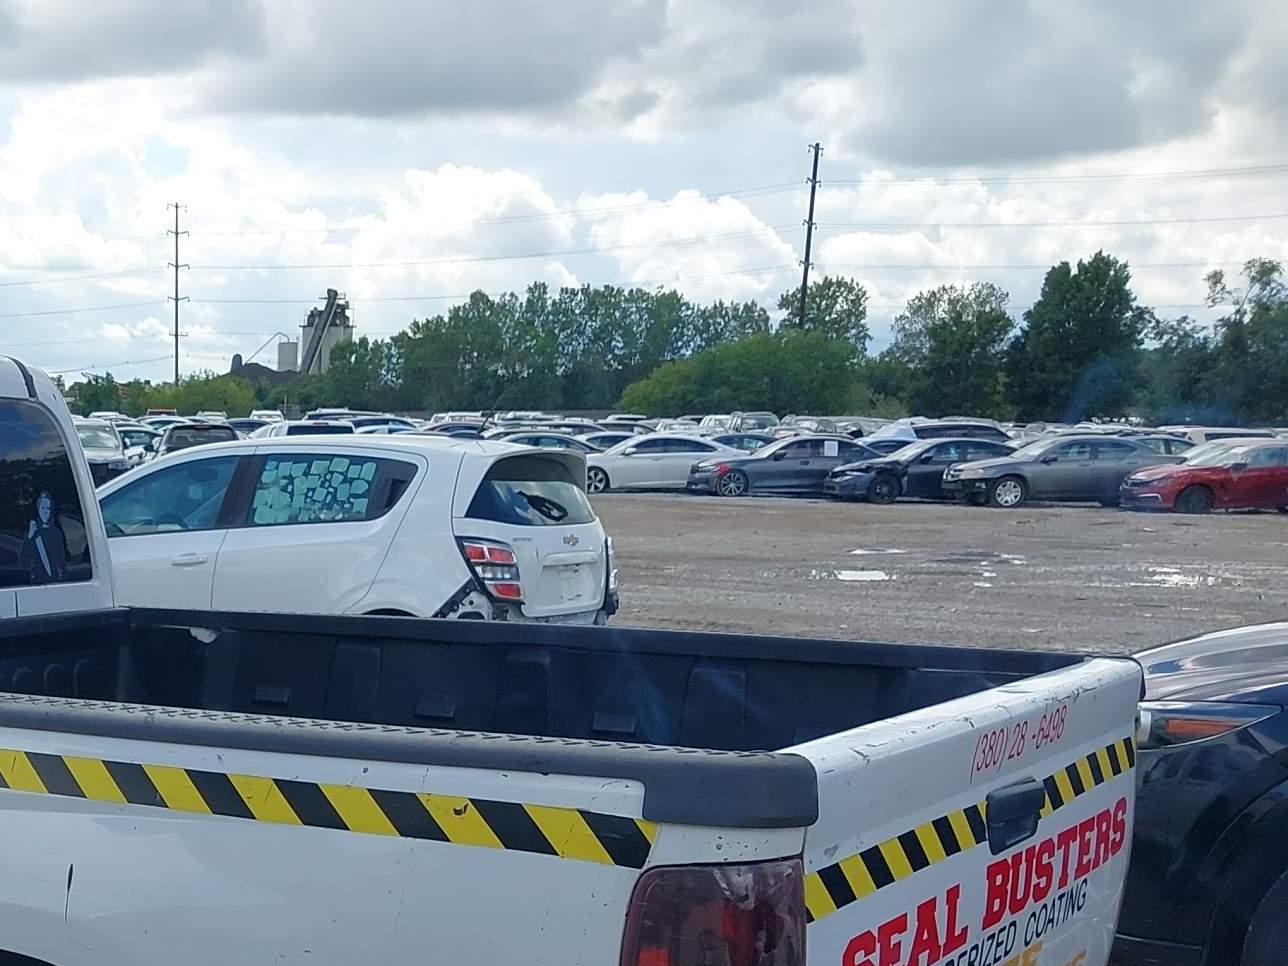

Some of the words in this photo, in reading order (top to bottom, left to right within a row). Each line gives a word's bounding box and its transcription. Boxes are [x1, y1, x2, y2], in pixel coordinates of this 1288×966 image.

[970, 726, 1008, 784] (380)
[1008, 720, 1028, 760] 28
[1032, 704, 1067, 749] -6498
[981, 796, 1127, 931] BUSTERS
[1024, 879, 1088, 948] COATING
